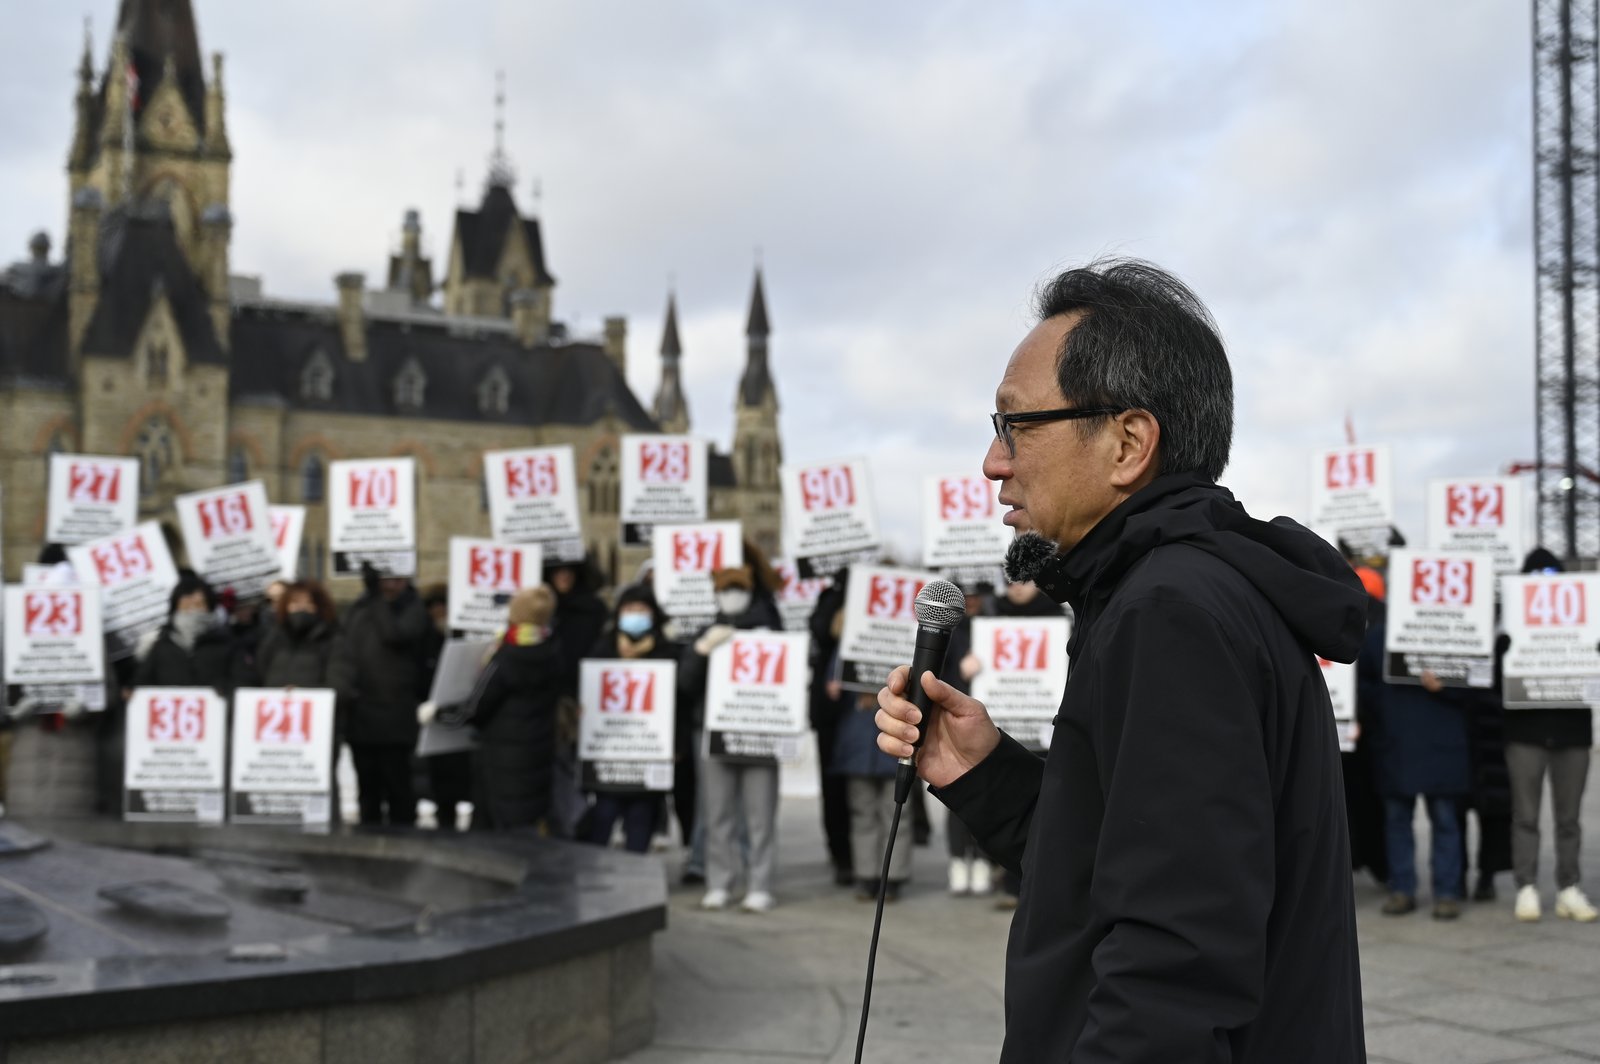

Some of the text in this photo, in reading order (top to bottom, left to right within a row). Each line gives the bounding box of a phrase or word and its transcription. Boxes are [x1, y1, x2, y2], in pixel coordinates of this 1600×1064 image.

[508, 457, 553, 497] 36
[643, 443, 686, 481] 28
[1329, 453, 1369, 488] 41
[73, 465, 117, 501] 27
[352, 470, 393, 508] 70
[804, 469, 851, 510] 90
[945, 479, 989, 519] 39
[202, 494, 250, 537] 16
[1451, 485, 1498, 526] 32
[98, 538, 151, 584] 35
[475, 549, 516, 587] 31
[676, 532, 717, 570] 37
[873, 577, 915, 617] 31
[1415, 561, 1469, 605] 38
[30, 593, 76, 633] 23
[1528, 584, 1579, 625] 40
[734, 642, 782, 683] 37
[998, 630, 1044, 670] 37
[605, 671, 651, 713] 37
[152, 699, 199, 741] 36
[260, 699, 303, 741] 21
